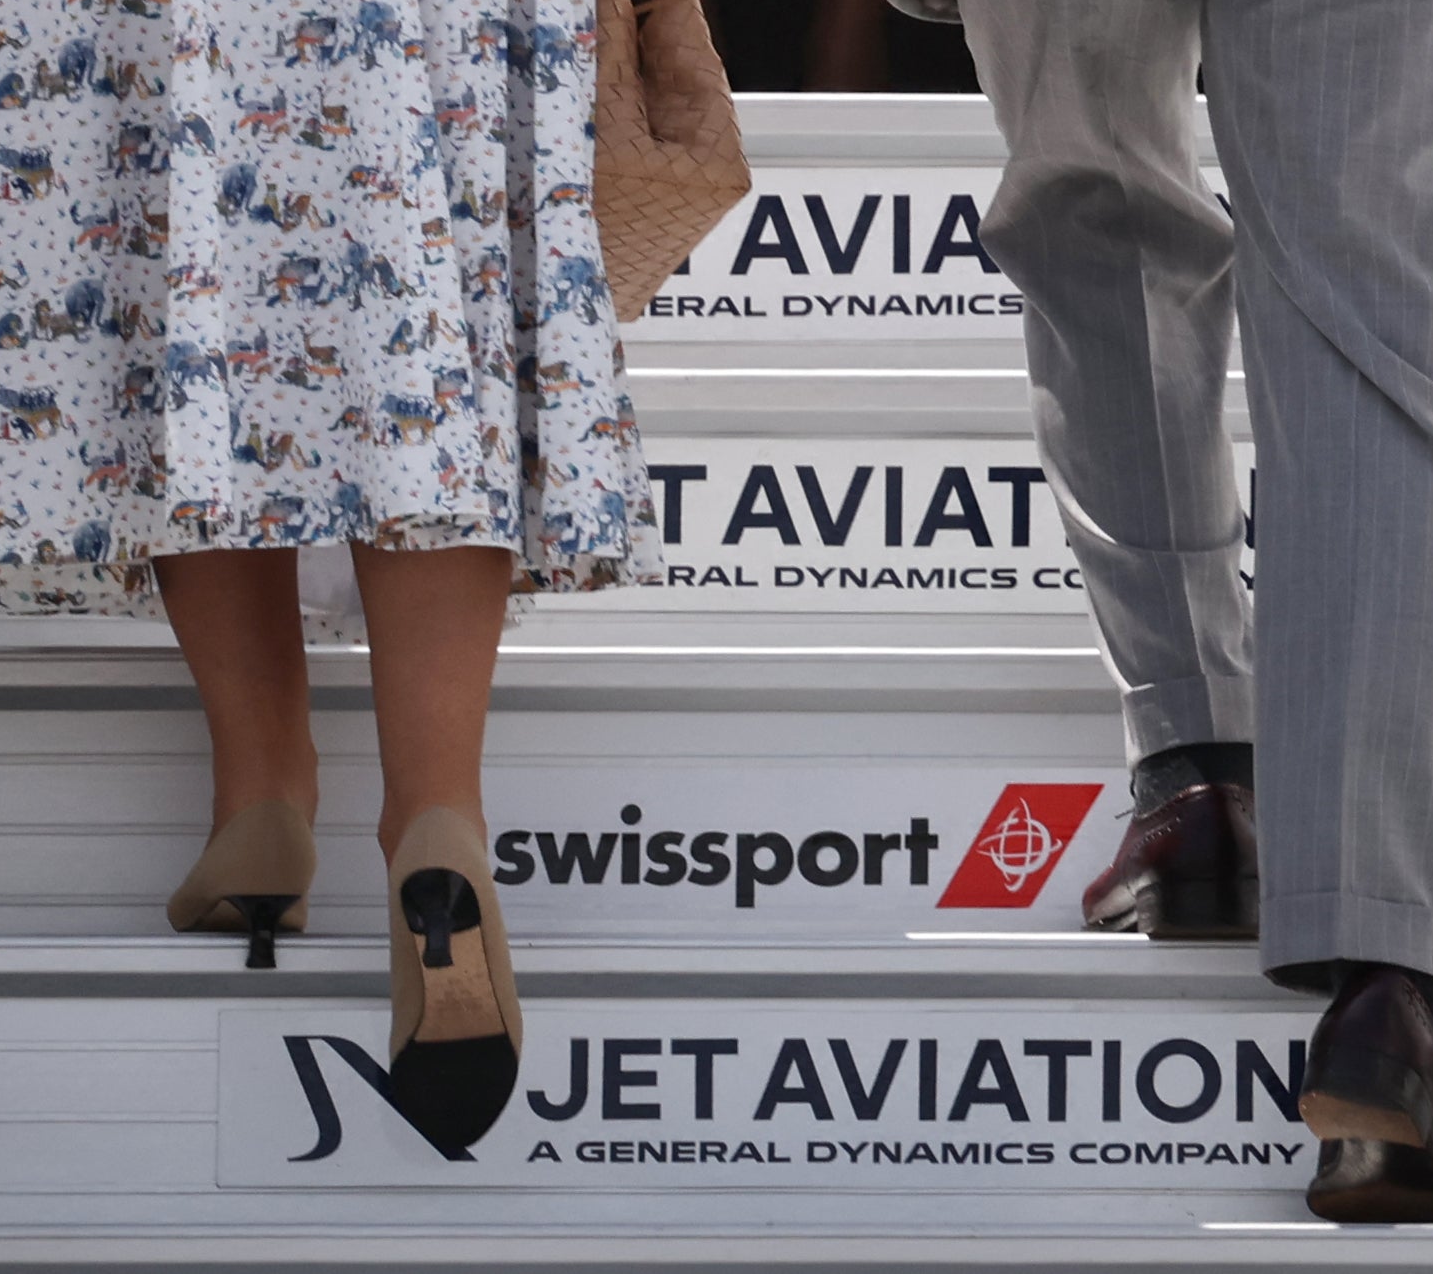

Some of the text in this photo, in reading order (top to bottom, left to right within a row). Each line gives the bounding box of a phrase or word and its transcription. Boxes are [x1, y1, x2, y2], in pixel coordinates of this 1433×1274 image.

[641, 294, 1024, 317] ERAL DYNAMICS
[721, 465, 1071, 548] AVIAT
[640, 565, 759, 587] RAL
[774, 565, 1018, 590] DYNAMICS
[493, 804, 939, 908] swissport
[526, 1037, 1307, 1124] JET AVIATION
[527, 1140, 1304, 1165] A GENERAL DYNAMICS COMPANY
